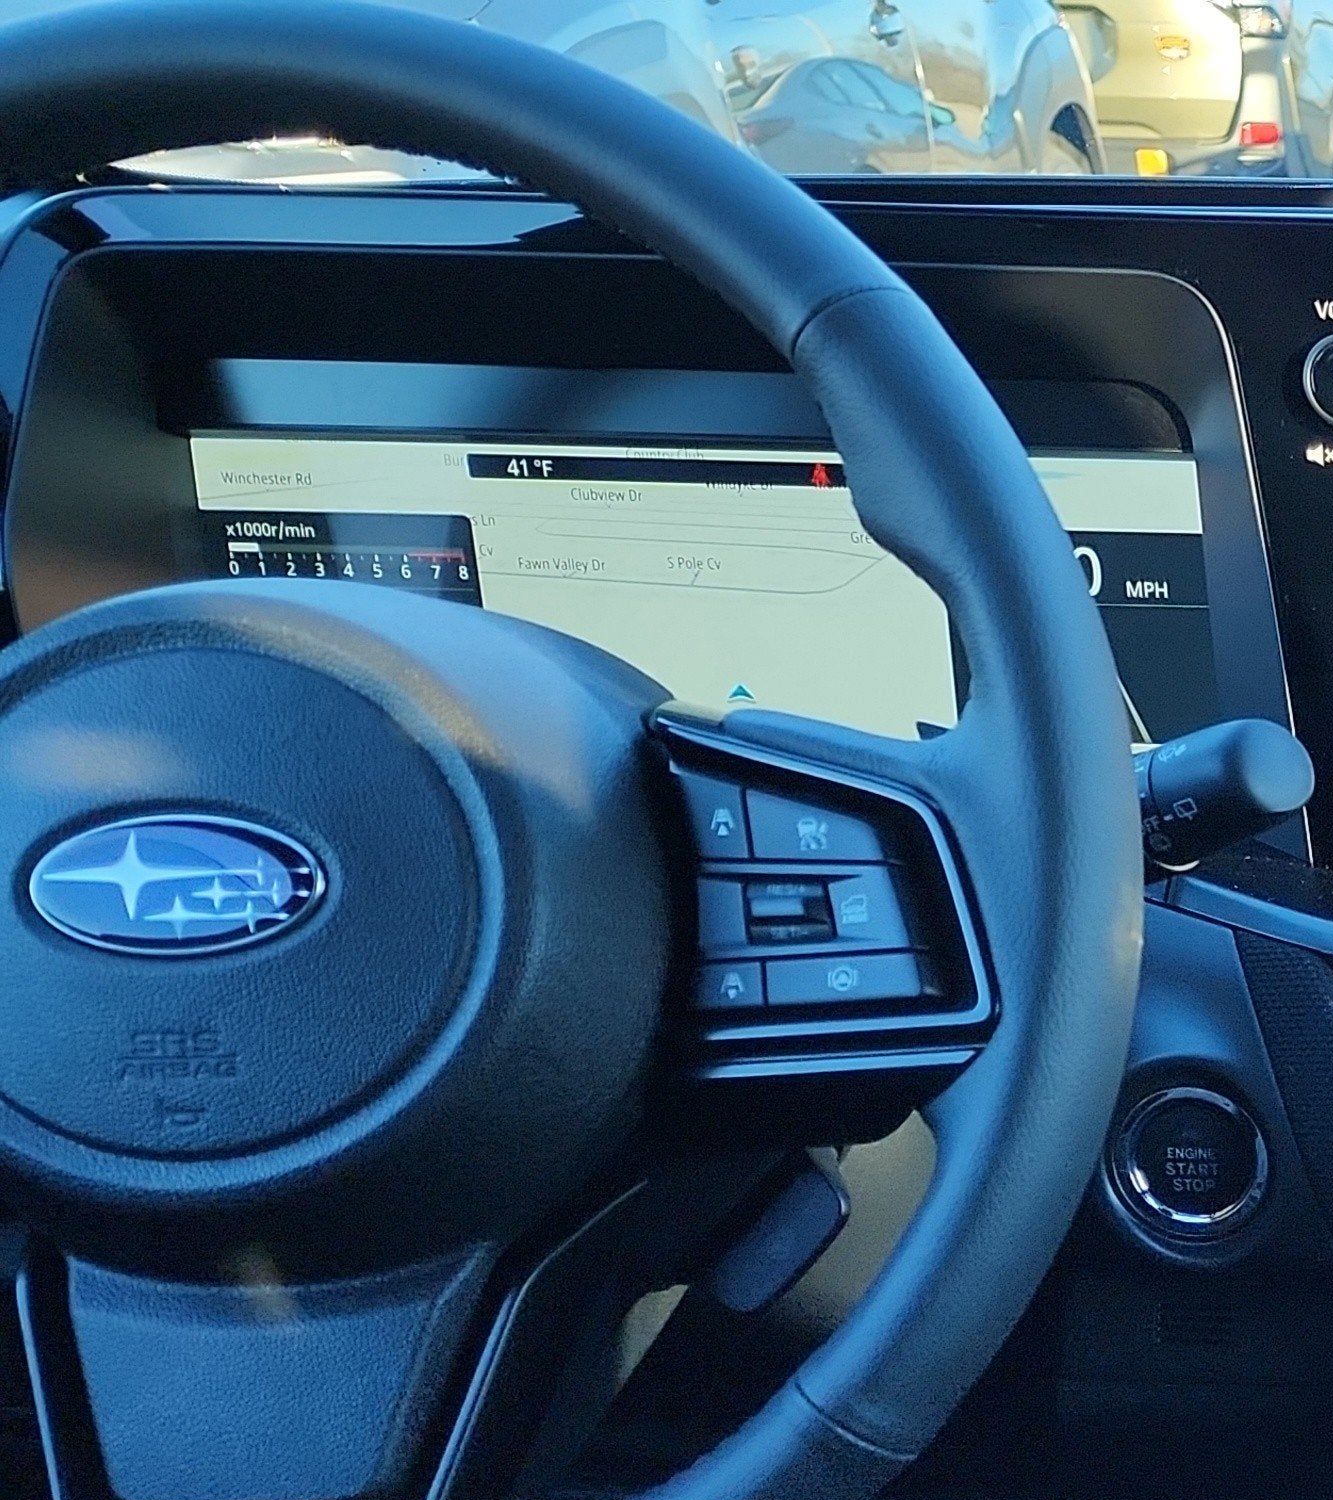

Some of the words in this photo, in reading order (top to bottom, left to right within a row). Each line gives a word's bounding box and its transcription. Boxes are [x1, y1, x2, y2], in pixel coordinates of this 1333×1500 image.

[220, 471, 291, 486] Winchester
[295, 473, 312, 486] Rd
[571, 488, 625, 501] Clubview
[628, 490, 642, 501] Dr
[226, 521, 316, 539] x1000r/min
[229, 560, 240, 576] 0
[258, 561, 266, 576] 1
[286, 561, 297, 576] 2
[315, 562, 325, 577] 3
[343, 562, 354, 577] 4
[372, 563, 383, 578] 5
[401, 564, 412, 579] 6
[430, 565, 441, 580] 7
[458, 565, 469, 580] 8
[518, 557, 550, 570] Fawn
[552, 557, 588, 573] Valley
[592, 559, 605, 571] Dr
[667, 557, 675, 569] S
[678, 557, 703, 570] Pole
[707, 558, 721, 570] Cv
[1125, 581, 1169, 599] MPH
[1167, 1147, 1215, 1159] ENGINE
[1165, 1162, 1220, 1176] START
[1173, 1179, 1216, 1192] STOP
